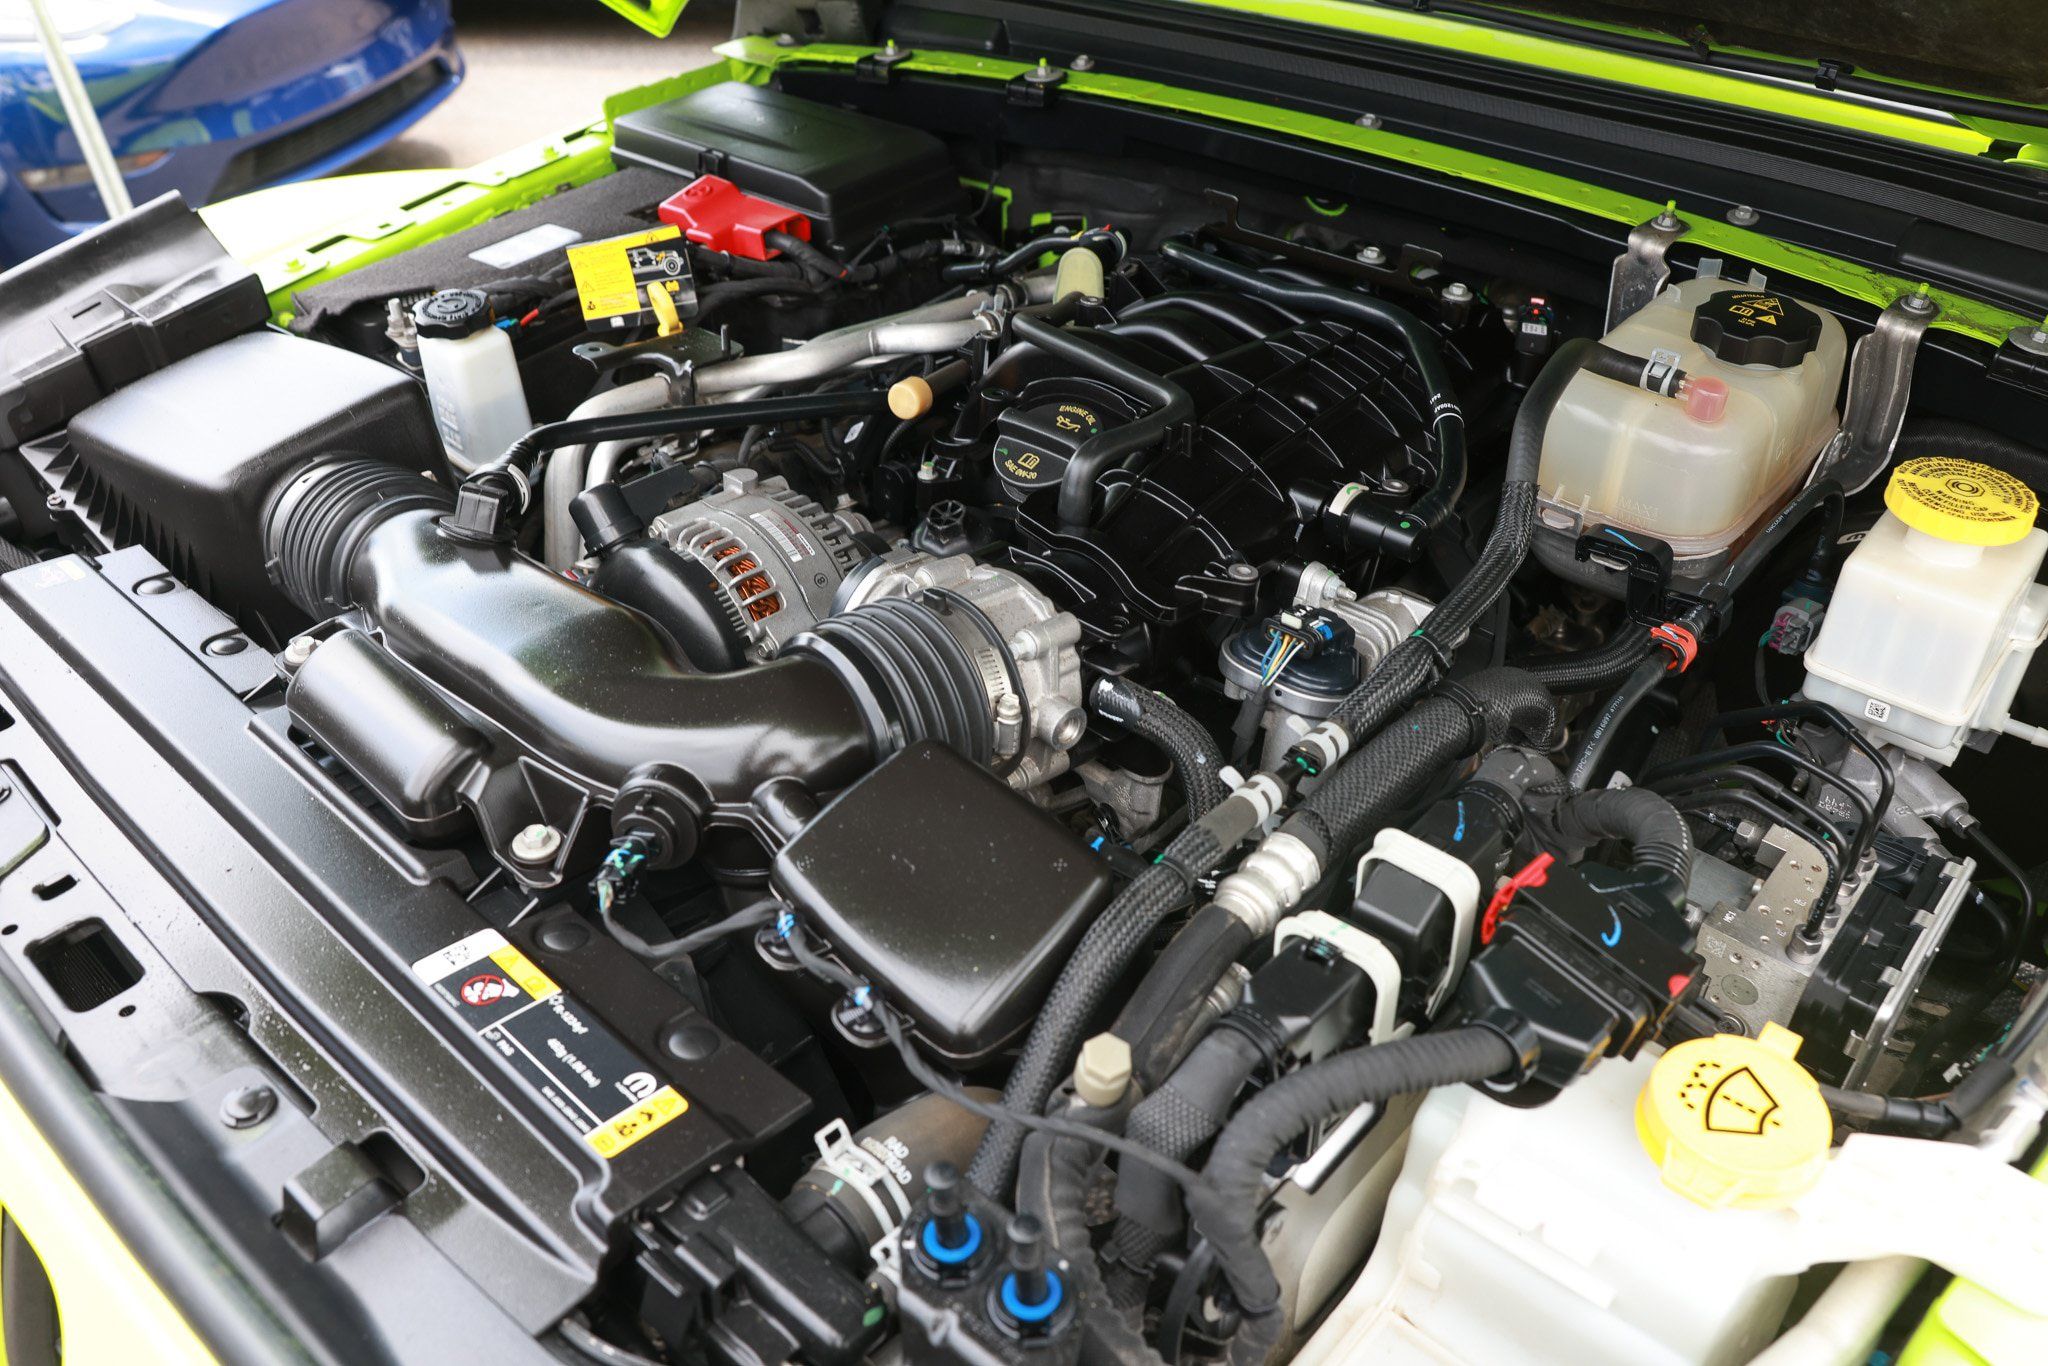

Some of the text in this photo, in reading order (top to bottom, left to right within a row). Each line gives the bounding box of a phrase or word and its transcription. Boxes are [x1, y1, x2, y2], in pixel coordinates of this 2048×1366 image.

[1059, 405, 1096, 426] ENGINE OIL
[1004, 459, 1038, 480] SAE 0W-20
[1936, 456, 1974, 466] NETTOYER
[1922, 489, 1944, 501] CLEAN
[1943, 499, 1971, 510] FILLER
[1936, 490, 1975, 506] WARNING
[1947, 511, 1977, 521] SEALED
